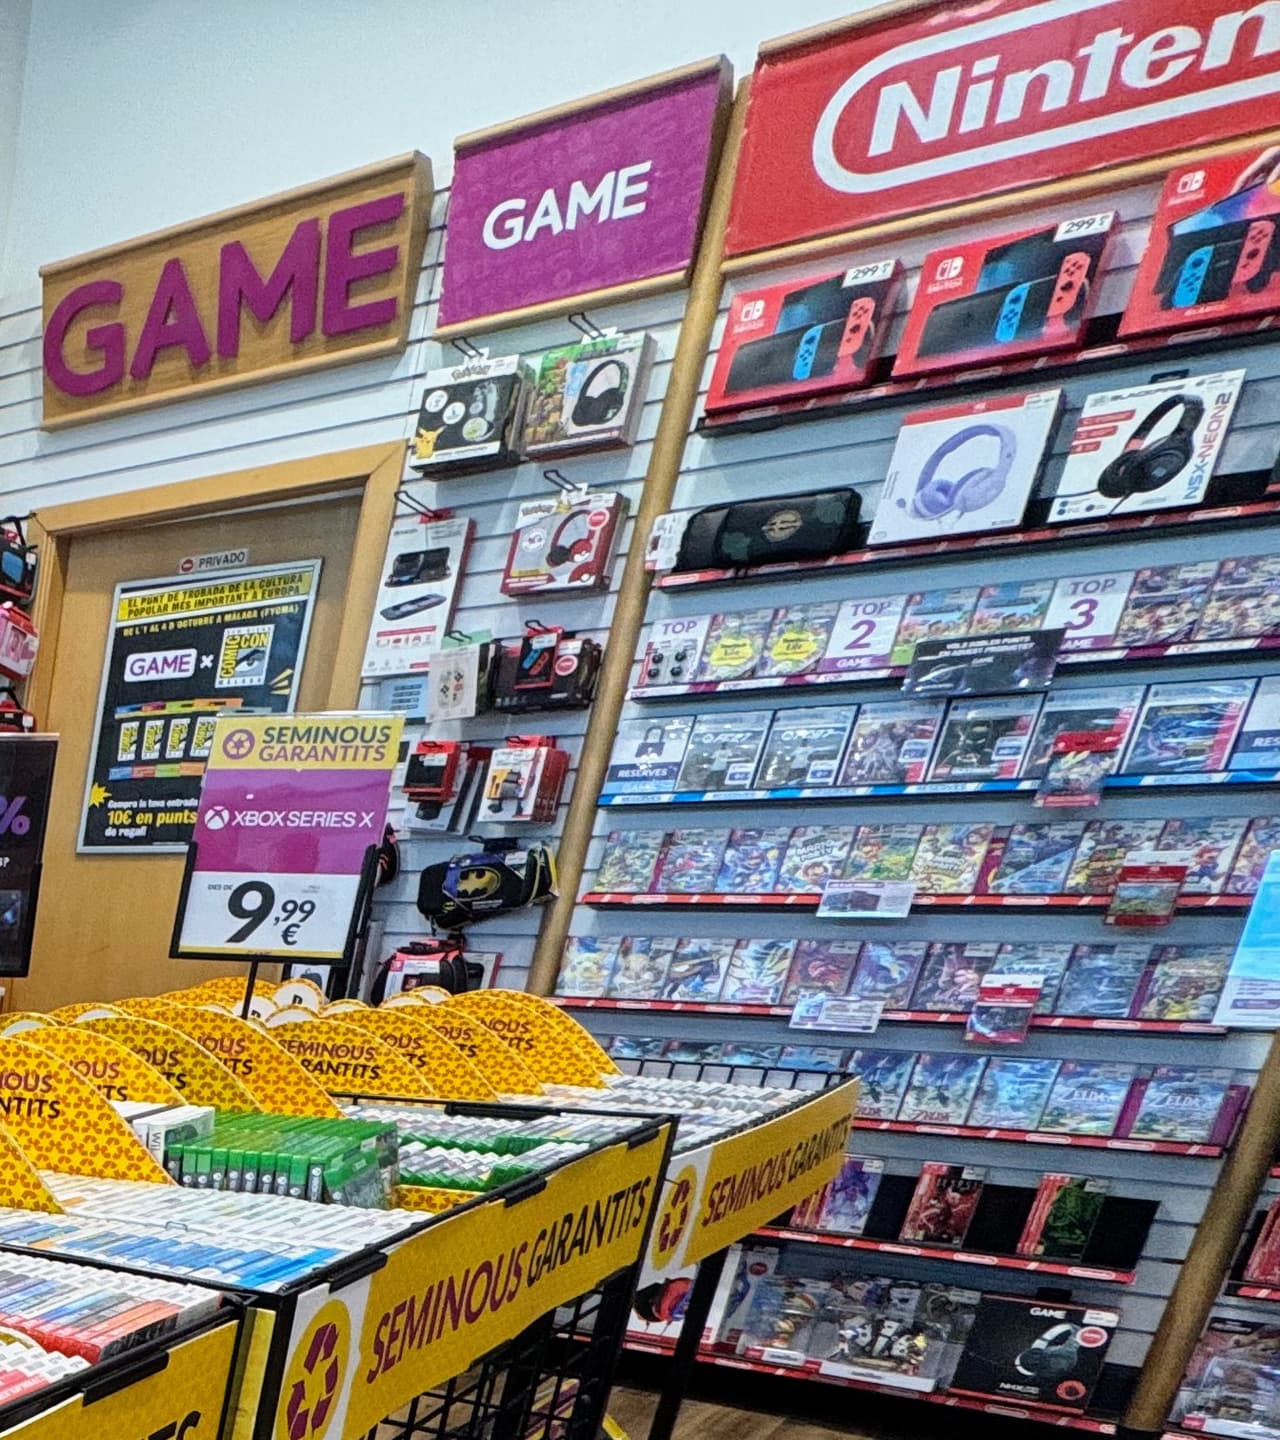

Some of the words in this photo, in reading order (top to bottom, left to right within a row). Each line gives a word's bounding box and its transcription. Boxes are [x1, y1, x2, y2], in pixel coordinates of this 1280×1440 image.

[868, 3, 1280, 157] Ninten
[483, 160, 652, 250] GAME
[43, 192, 404, 396] GAME
[199, 552, 245, 569] PRIVADO
[1069, 577, 1117, 595] TOP
[851, 600, 891, 616] TOP
[1064, 598, 1100, 631] 3
[662, 621, 697, 636] TOP
[843, 620, 877, 651] 2
[241, 632, 269, 647] CON
[130, 653, 191, 677] GAME
[263, 725, 392, 745] SEMINOUS
[259, 744, 386, 763] GARANTITS
[156, 809, 197, 827] punts
[232, 810, 287, 827] XBOX
[287, 811, 356, 828] SERIES
[280, 1039, 376, 1061] SEMINOUS
[702, 1152, 792, 1227] SEMINOUS
[366, 1242, 528, 1386] SEMINOUS
[526, 1174, 649, 1288] GARANTITS
